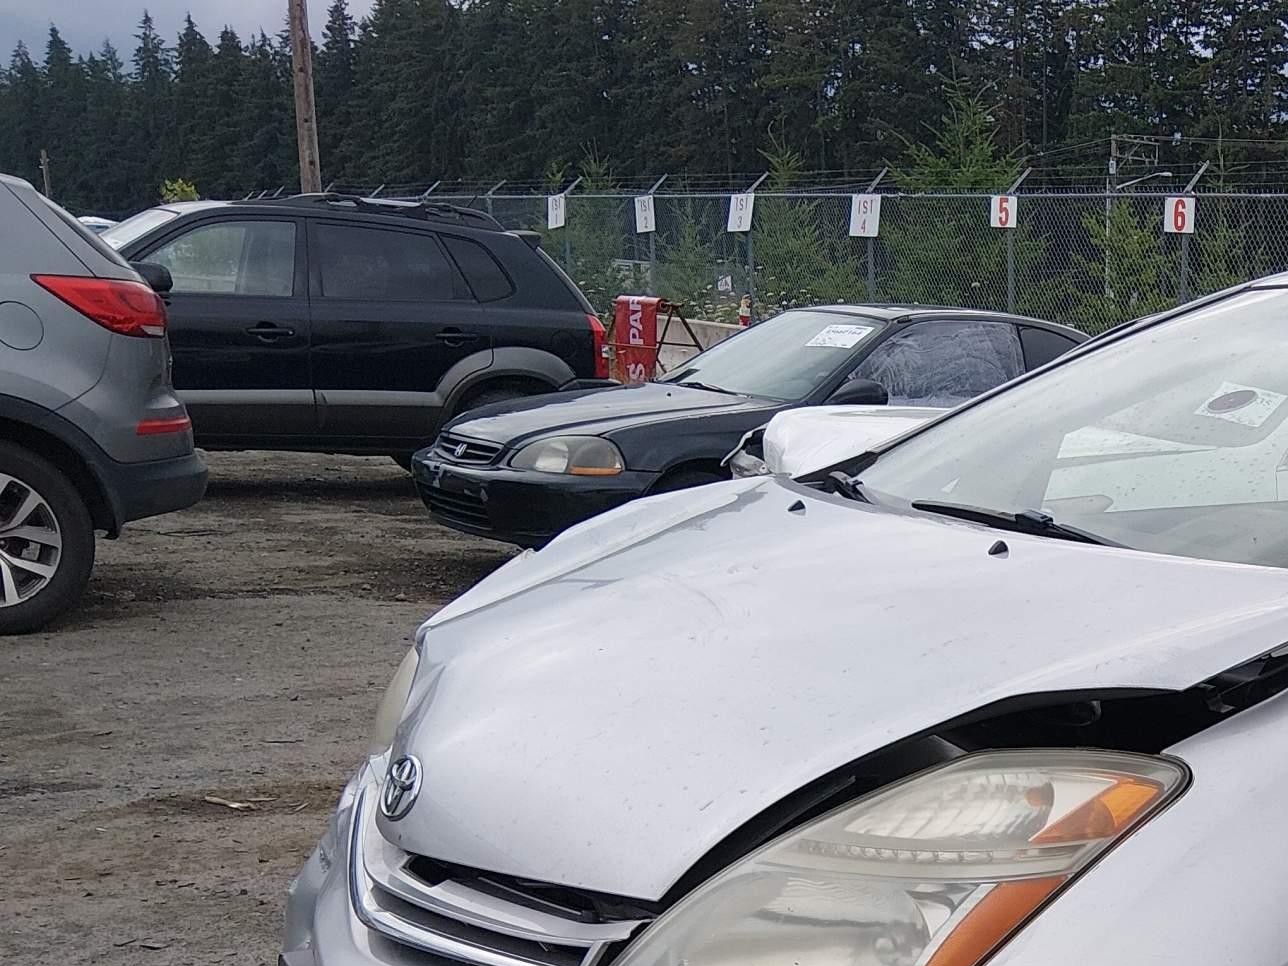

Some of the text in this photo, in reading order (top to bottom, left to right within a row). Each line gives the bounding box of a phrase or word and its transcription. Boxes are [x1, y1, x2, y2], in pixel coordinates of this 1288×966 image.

[736, 215, 743, 229] 3
[998, 197, 1010, 226] 5
[1172, 198, 1187, 232] 6
